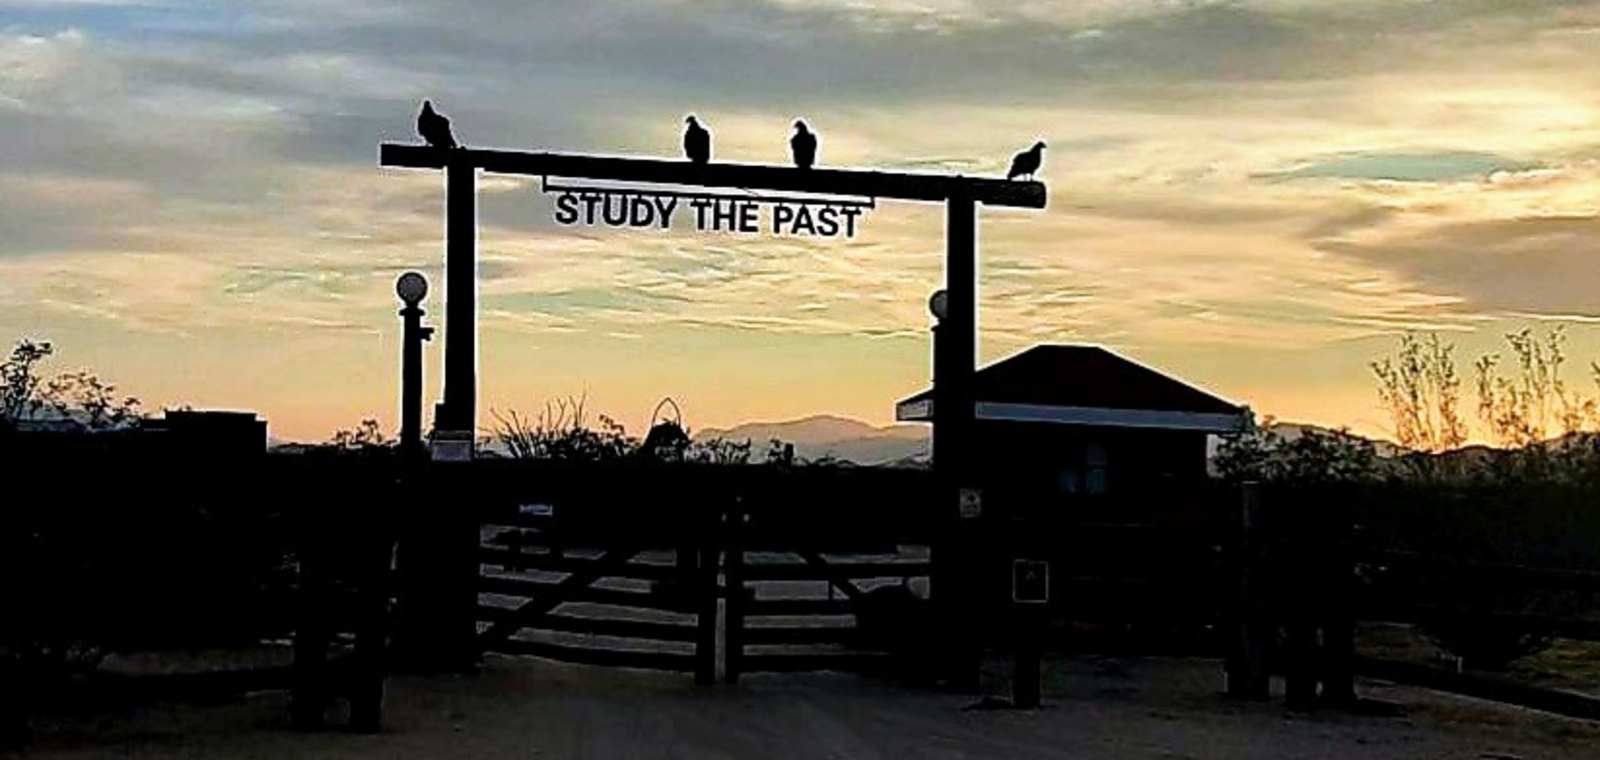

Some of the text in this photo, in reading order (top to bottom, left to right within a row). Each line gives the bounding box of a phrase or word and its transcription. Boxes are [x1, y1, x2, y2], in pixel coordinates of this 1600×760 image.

[555, 193, 862, 238] STUDY THE PAST
